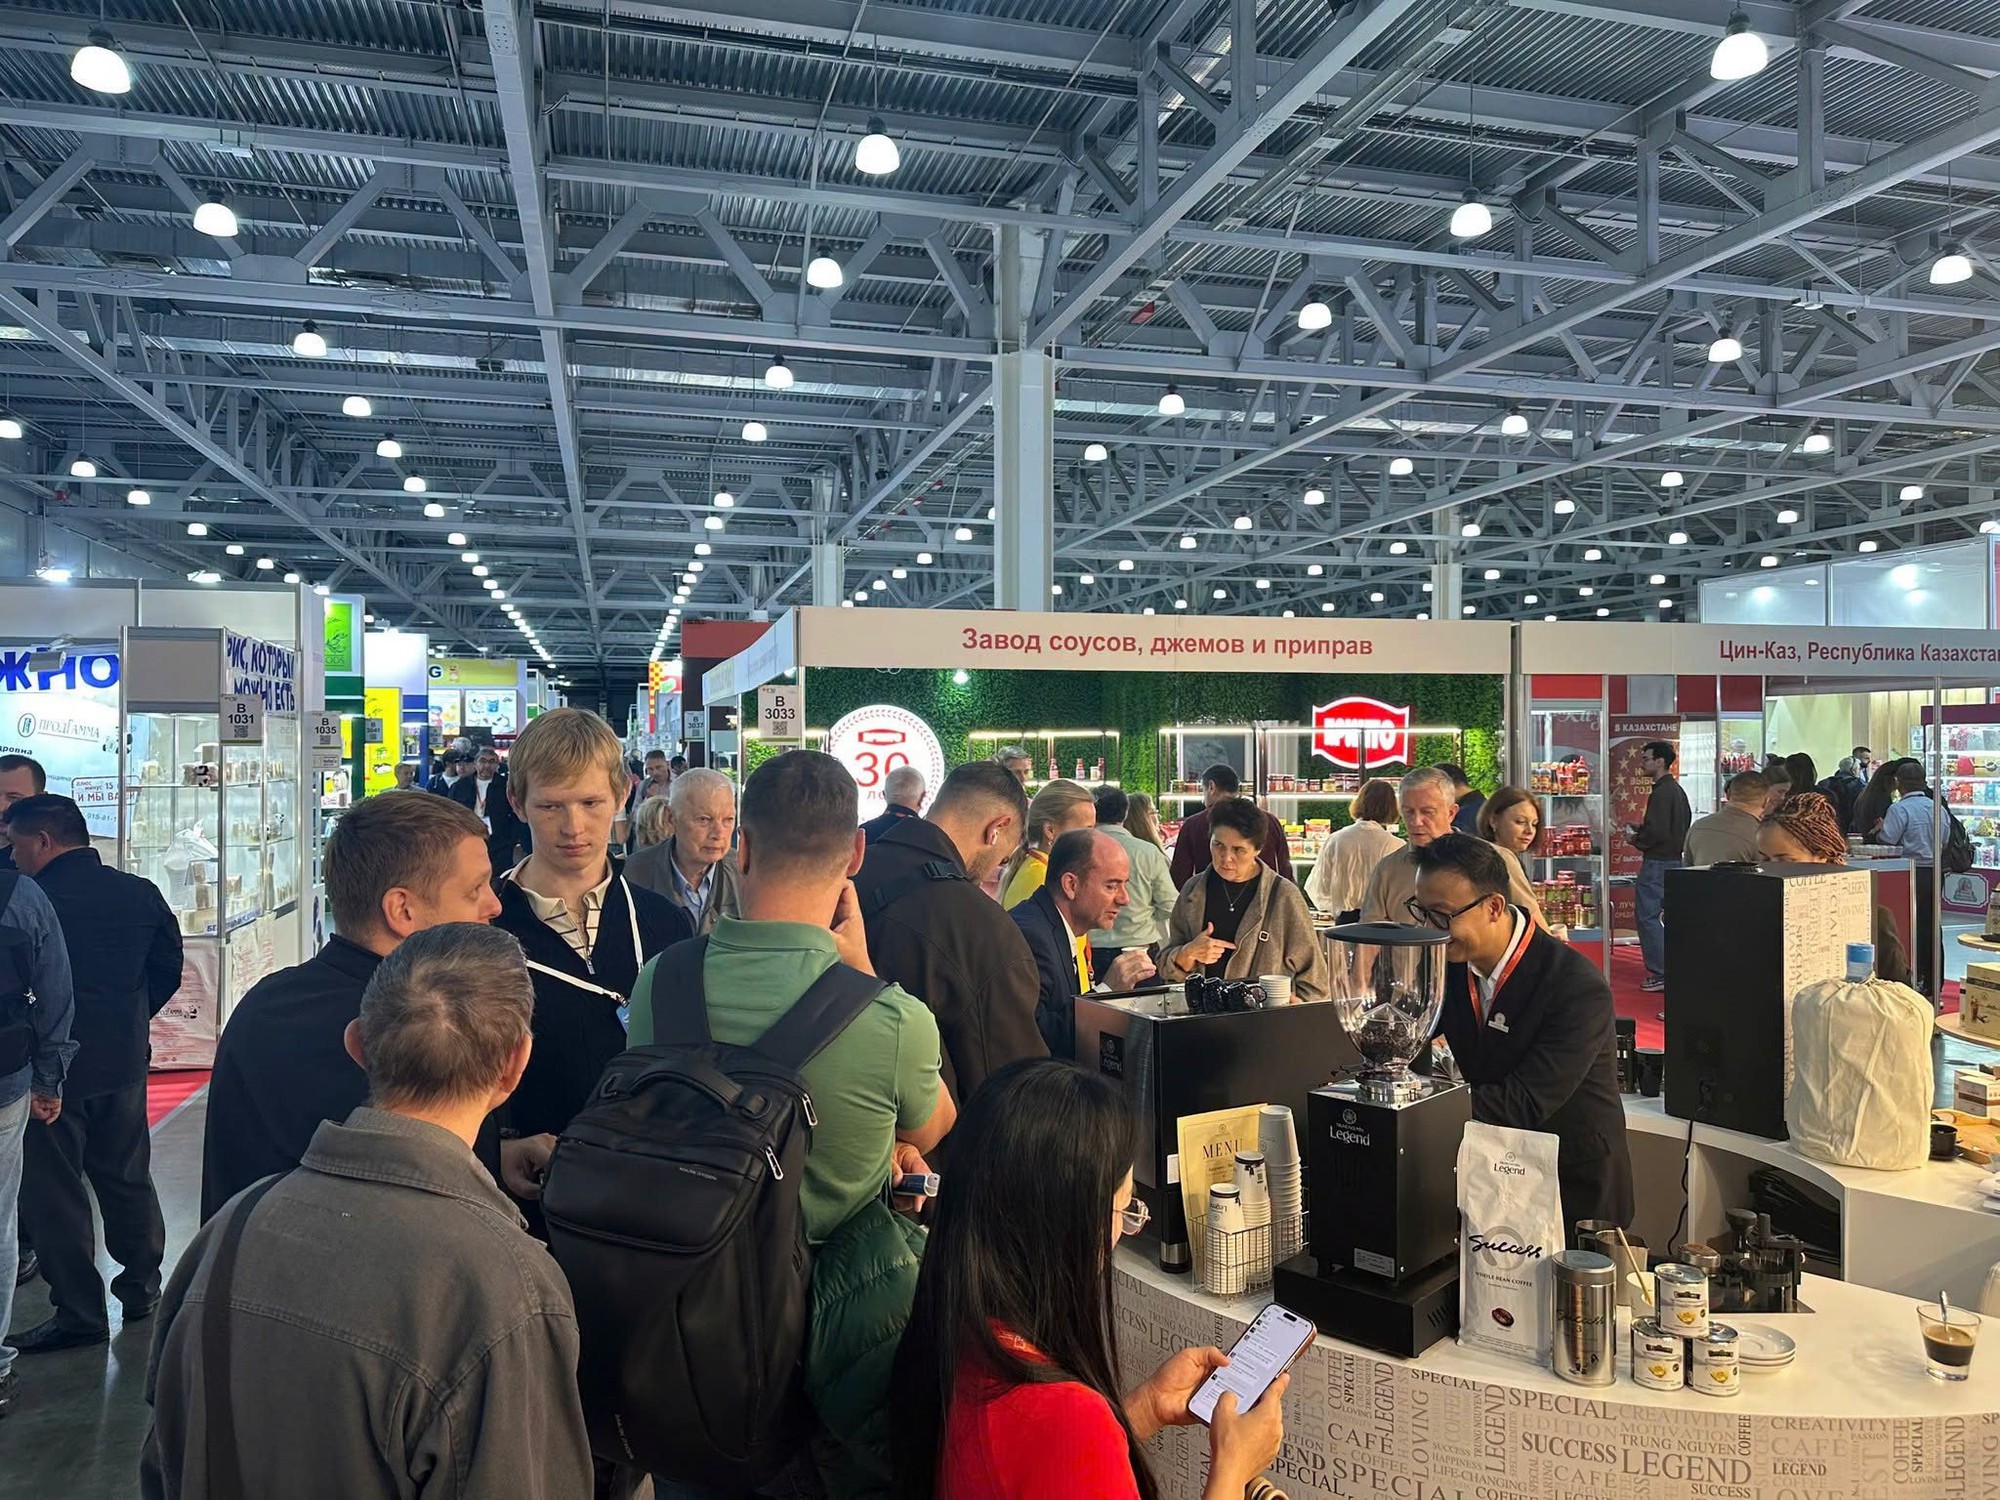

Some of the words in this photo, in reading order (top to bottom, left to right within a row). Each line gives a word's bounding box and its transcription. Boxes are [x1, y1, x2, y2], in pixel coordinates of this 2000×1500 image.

[962, 627, 1041, 653] Завод
[1050, 632, 1143, 656] соусов,
[1150, 635, 1245, 656] джемов
[1253, 637, 1266, 654] и
[1274, 637, 1373, 657] приправ
[1720, 640, 1801, 662] Цин-Каз,
[1808, 642, 1915, 665] Республика
[236, 703, 246, 713] B
[776, 695, 785, 707] B
[228, 714, 254, 724] 1031
[321, 718, 330, 726] B
[765, 708, 795, 720] 3033
[315, 726, 337, 735] 1035
[1623, 723, 1677, 732] КАЗАХСТАНЕ
[855, 752, 910, 787] 30
[1330, 1125, 1370, 1146] Legend
[1203, 1138, 1244, 1160] MENU
[1494, 1163, 1526, 1176] Legend
[1468, 1234, 1543, 1259] Success
[1512, 1278, 1533, 1288] COFFEE
[1328, 1348, 1342, 1410] COFFEE
[1343, 1353, 1355, 1405] SPECIAL
[1411, 1368, 1482, 1392] SPECIAL
[1374, 1361, 1395, 1435] LEGEND
[1509, 1387, 1618, 1421] SPECIAL
[1522, 1413, 1617, 1440] EDITION
[1619, 1404, 1736, 1429] CREATIVITY
[1771, 1416, 1889, 1431] CREATIVITY
[1327, 1422, 1394, 1457] CAFÉ
[1411, 1389, 1430, 1480] LOVING
[1484, 1384, 1506, 1475] LEGEND
[1620, 1421, 1737, 1442] MOTIVATION
[1738, 1414, 1752, 1457] COFFEE
[1176, 1424, 1190, 1481] LEGEN
[1278, 1441, 1326, 1471] END
[1521, 1431, 1618, 1465] SUCCESS
[1620, 1433, 1671, 1450] TRUNG
[1676, 1439, 1737, 1455] NGUYEN
[1893, 1418, 1910, 1484] COFFEE
[1911, 1417, 1923, 1473] SPECIAL
[1944, 1416, 1966, 1493] LEGEND
[1433, 1452, 1483, 1471] HAPPINESS
[1620, 1447, 1752, 1485] LEGEND
[1772, 1462, 1827, 1477] LEGEND
[1432, 1463, 1528, 1493] LIFE-CHANGING
[1554, 1465, 1618, 1489] CAFÉ
[1690, 1483, 1752, 1498] SUCCESS
